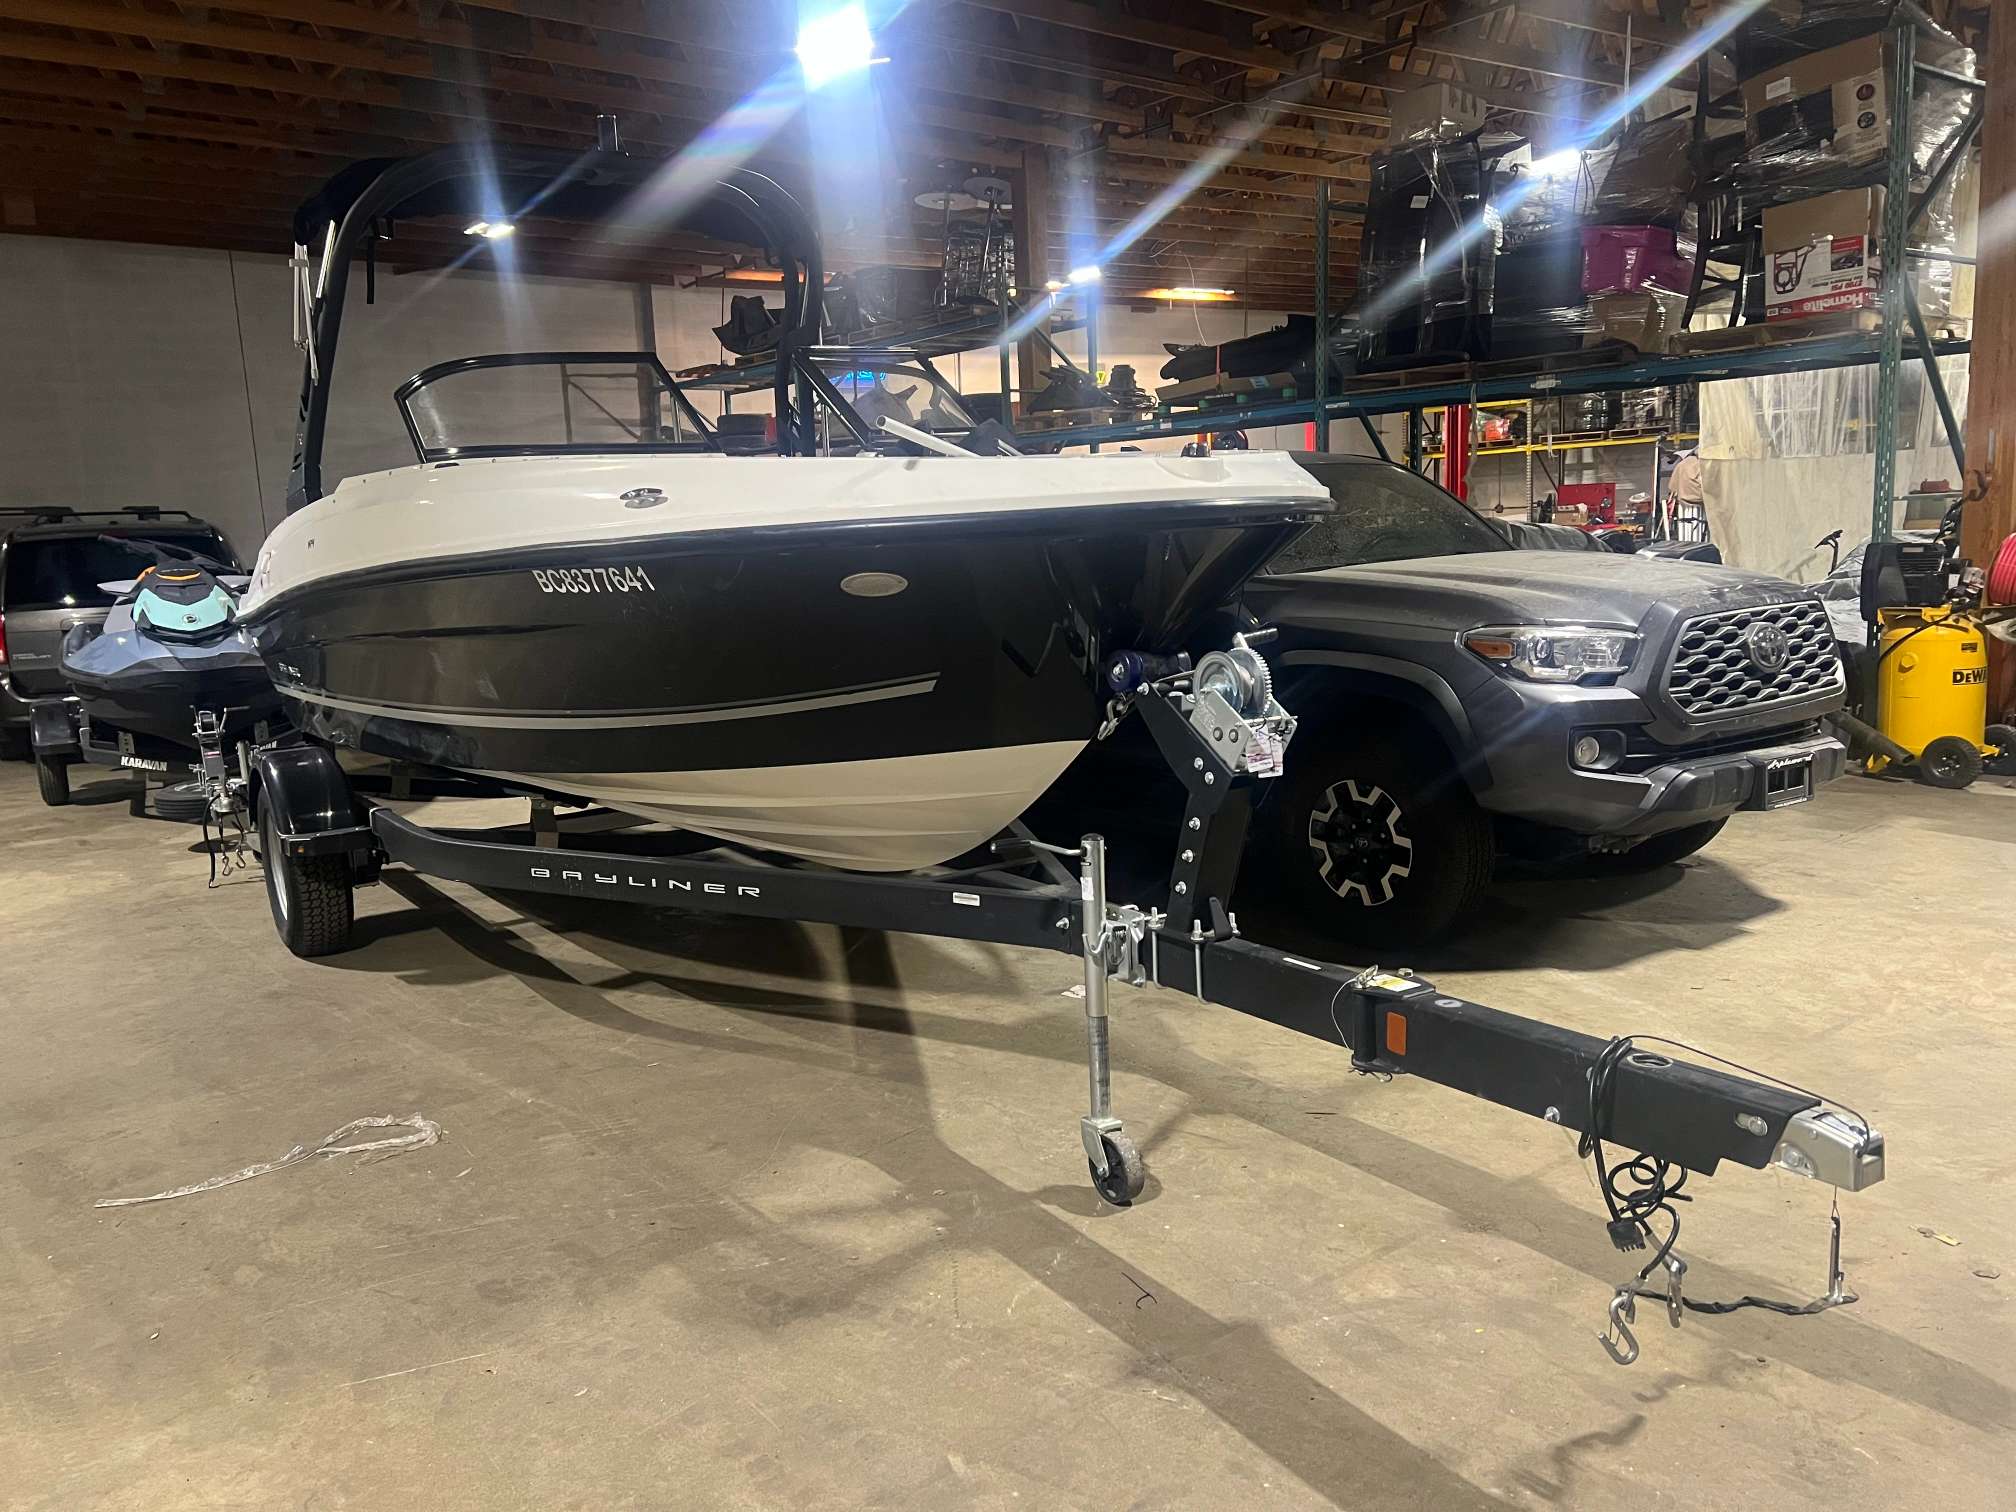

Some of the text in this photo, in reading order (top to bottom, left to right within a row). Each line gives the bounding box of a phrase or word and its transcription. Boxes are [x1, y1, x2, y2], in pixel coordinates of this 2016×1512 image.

[1802, 292, 1864, 313] Homelite
[532, 566, 655, 593] BC8377641
[121, 756, 168, 772] KARAVAN
[531, 867, 760, 897] BAYLINER
